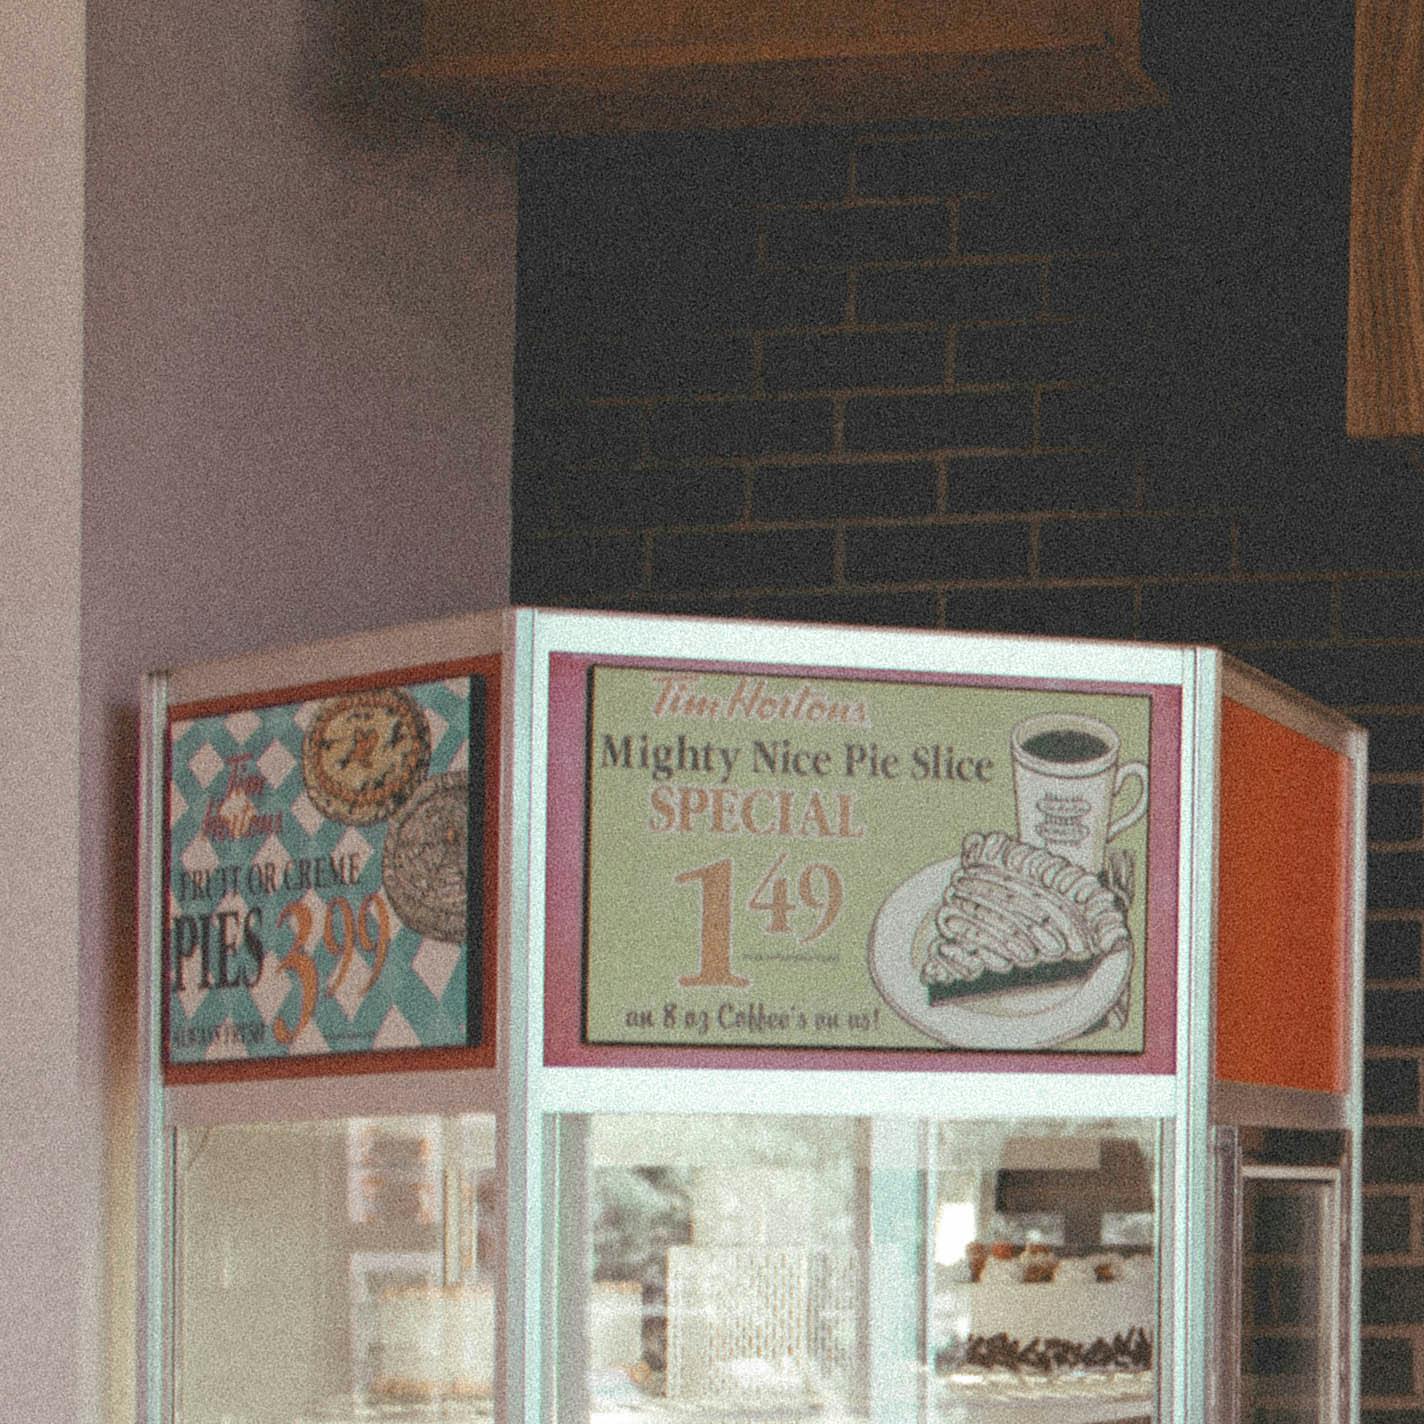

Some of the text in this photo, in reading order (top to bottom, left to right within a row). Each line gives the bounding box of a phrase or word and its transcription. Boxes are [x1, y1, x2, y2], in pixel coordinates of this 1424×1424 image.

[599, 733, 995, 784] Mighty Nice Pie Slice
[649, 785, 864, 838] SPECIAL
[249, 860, 283, 896] OR
[172, 906, 264, 992] PIES
